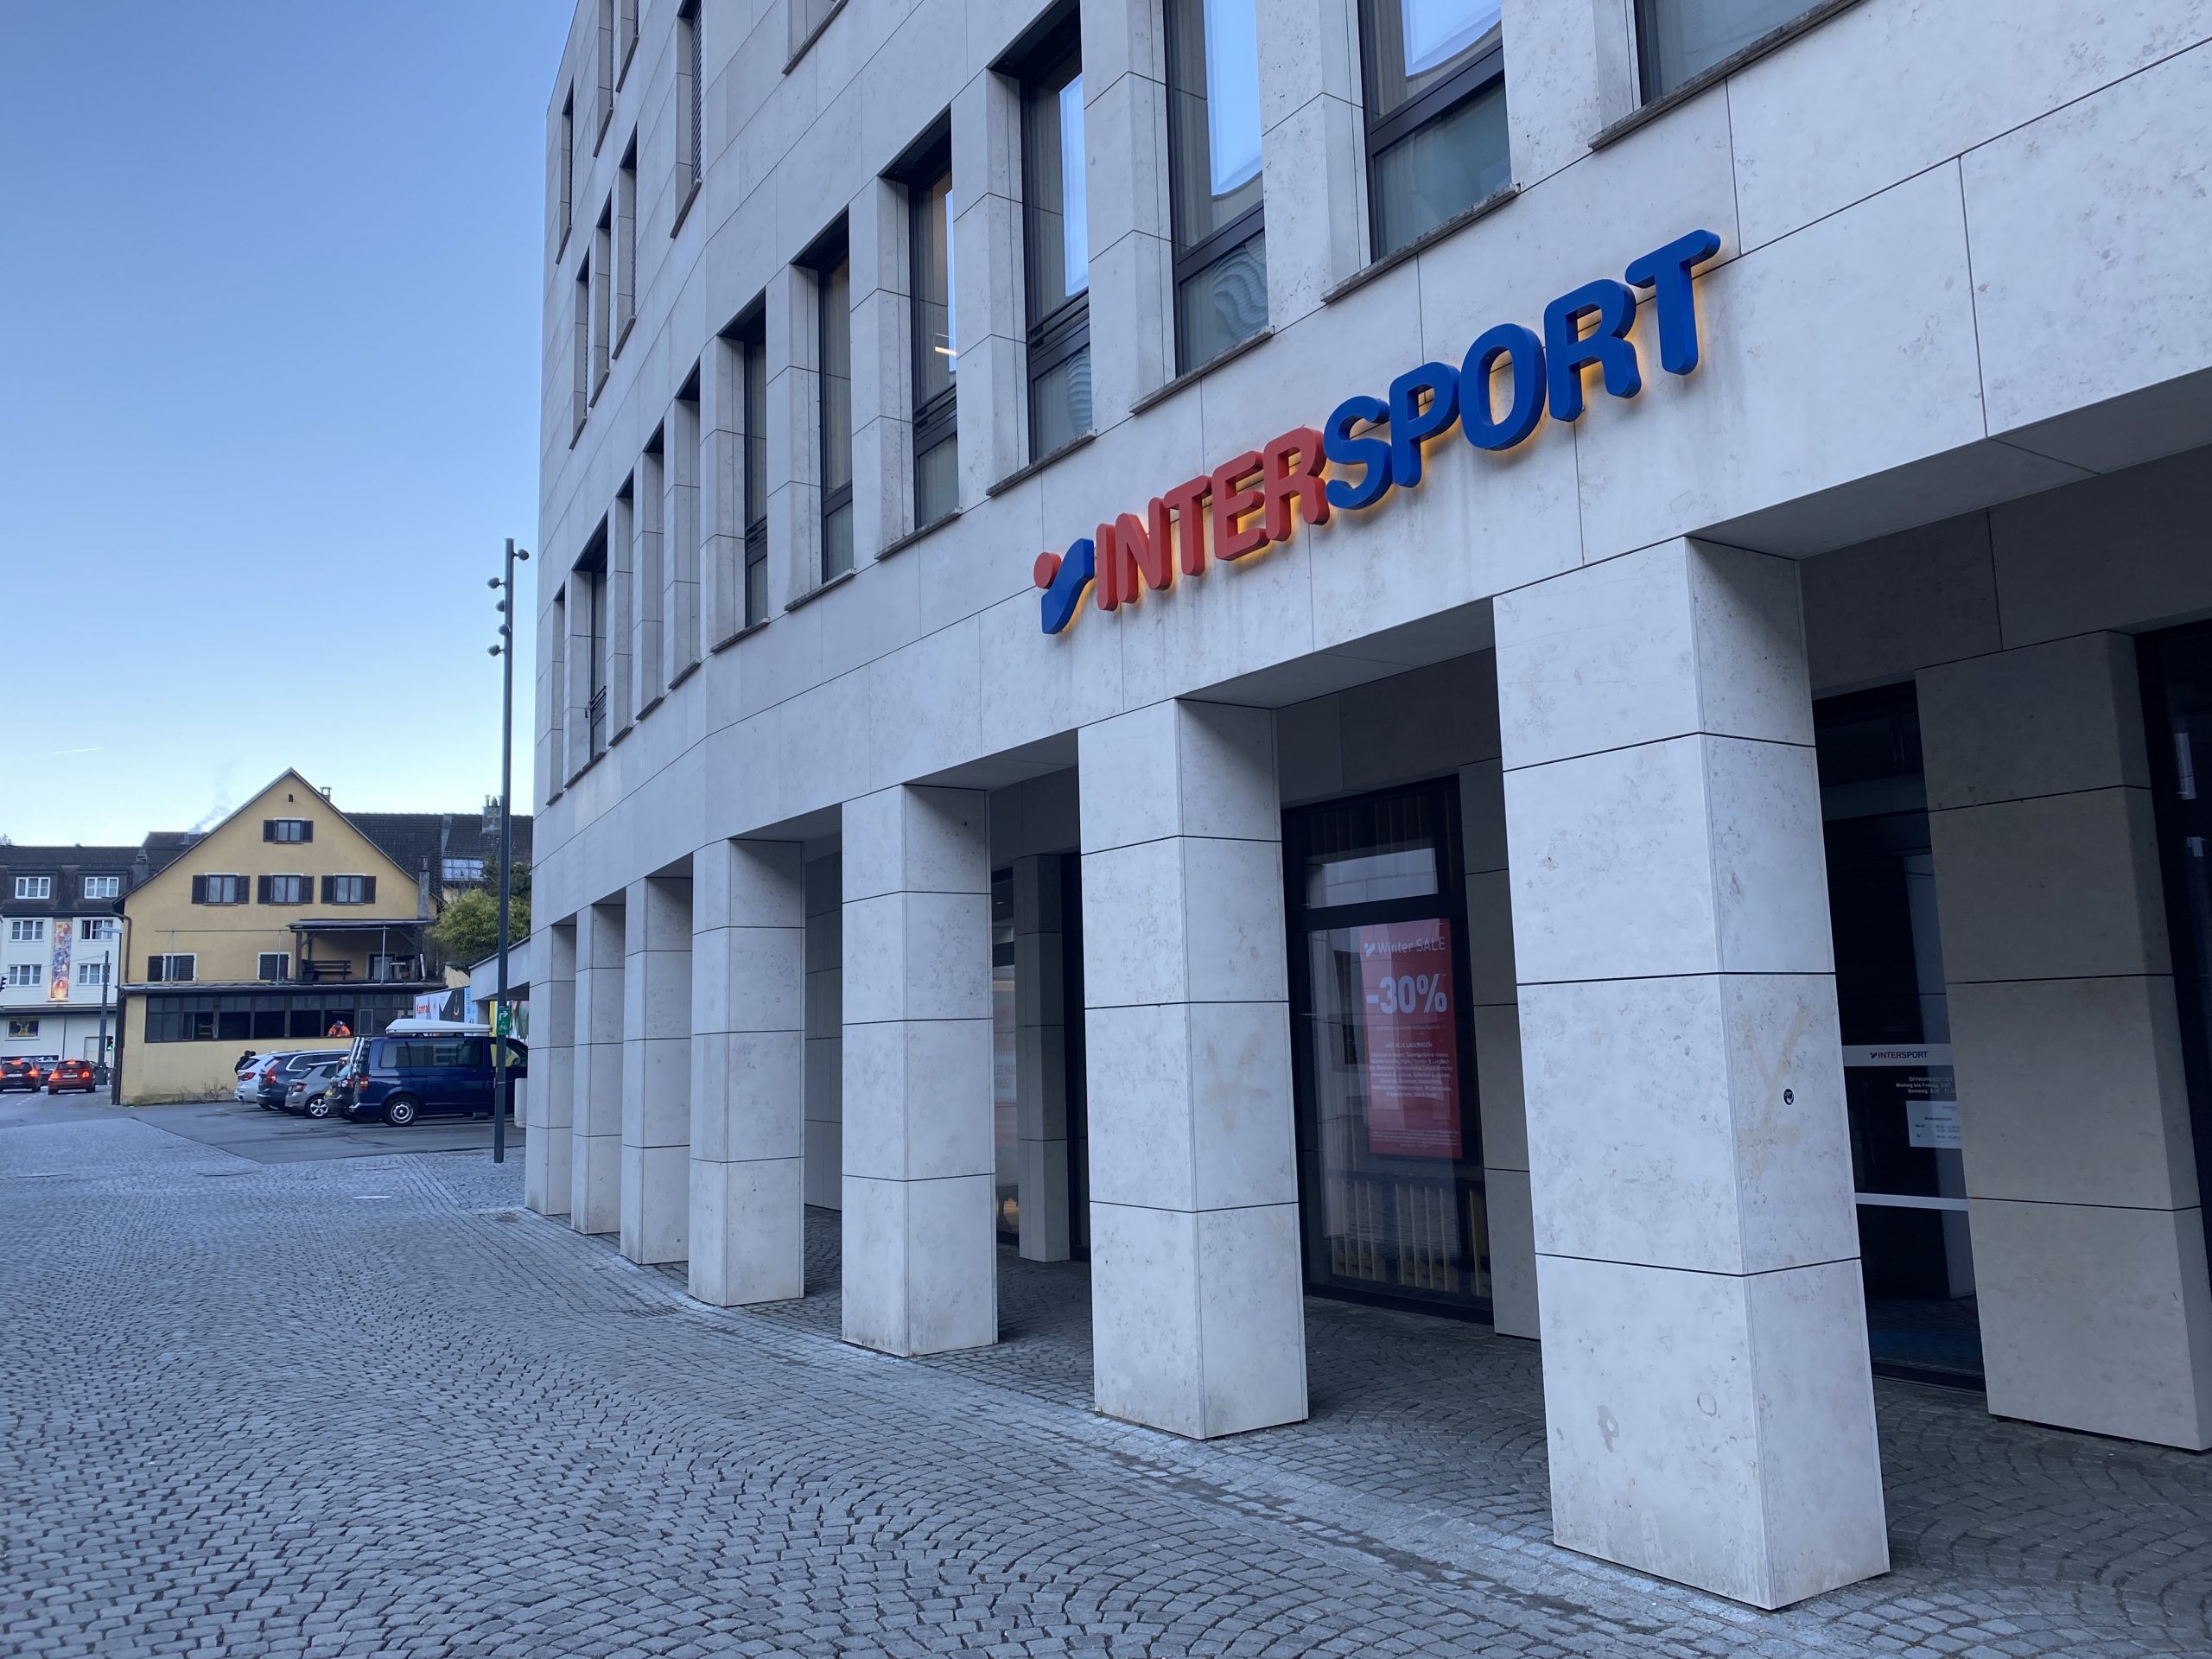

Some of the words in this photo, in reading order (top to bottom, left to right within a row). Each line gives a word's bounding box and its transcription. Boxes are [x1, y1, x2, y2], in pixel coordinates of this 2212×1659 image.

[1096, 229, 1721, 611] INTERSPORT
[1377, 942, 1414, 955] Winter
[1416, 937, 1446, 952] SALE
